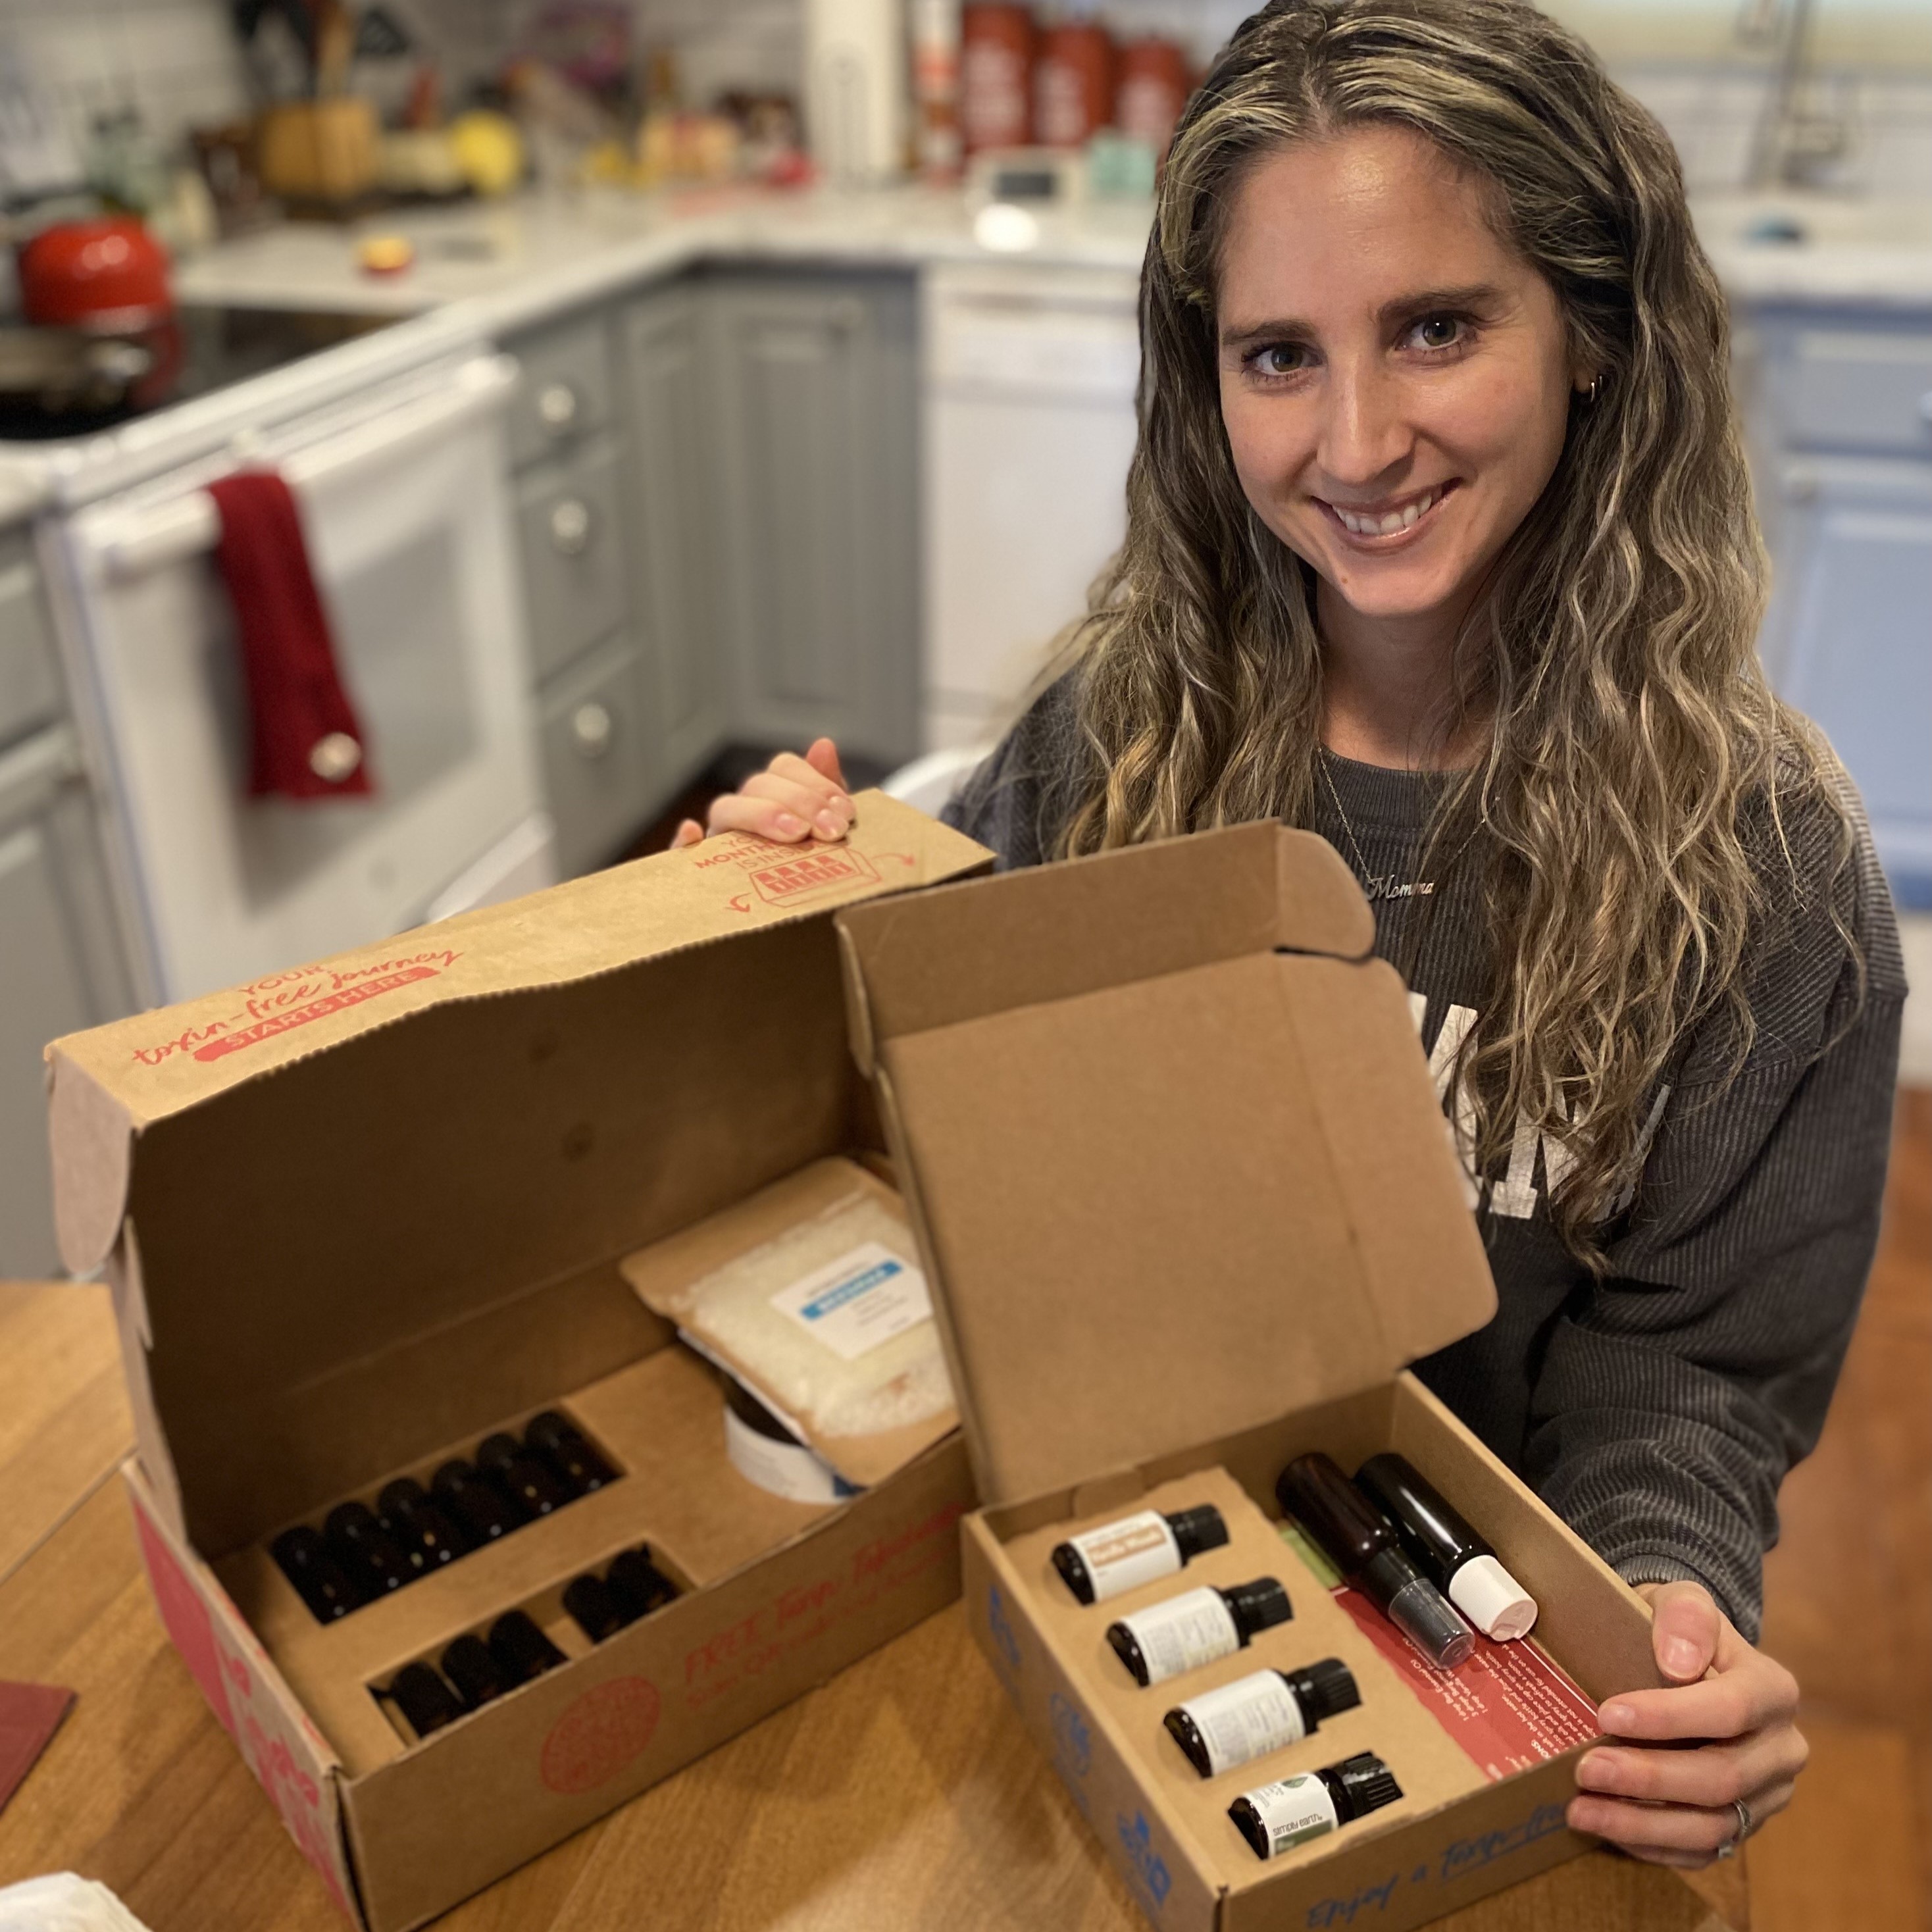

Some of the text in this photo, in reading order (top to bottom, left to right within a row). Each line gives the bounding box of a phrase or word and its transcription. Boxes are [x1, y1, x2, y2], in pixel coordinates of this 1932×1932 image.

[239, 964, 328, 996] YOUR
[132, 949, 465, 1065] toxin-free journey
[224, 970, 420, 1048] STARTS HERE
[1508, 1650, 1519, 1660] the
[1418, 1668, 1444, 1694] Essential
[1488, 1668, 1499, 1679] the
[1508, 1691, 1523, 1702] and
[1544, 1714, 1559, 1725] and
[1550, 1706, 1567, 1721] spray
[1526, 1721, 1538, 1732] the
[1537, 1719, 1554, 1735] spray
[1563, 1721, 1579, 1732] and
[1273, 1821, 1299, 1837] simply
[1307, 1874, 1400, 1928] Enjoy
